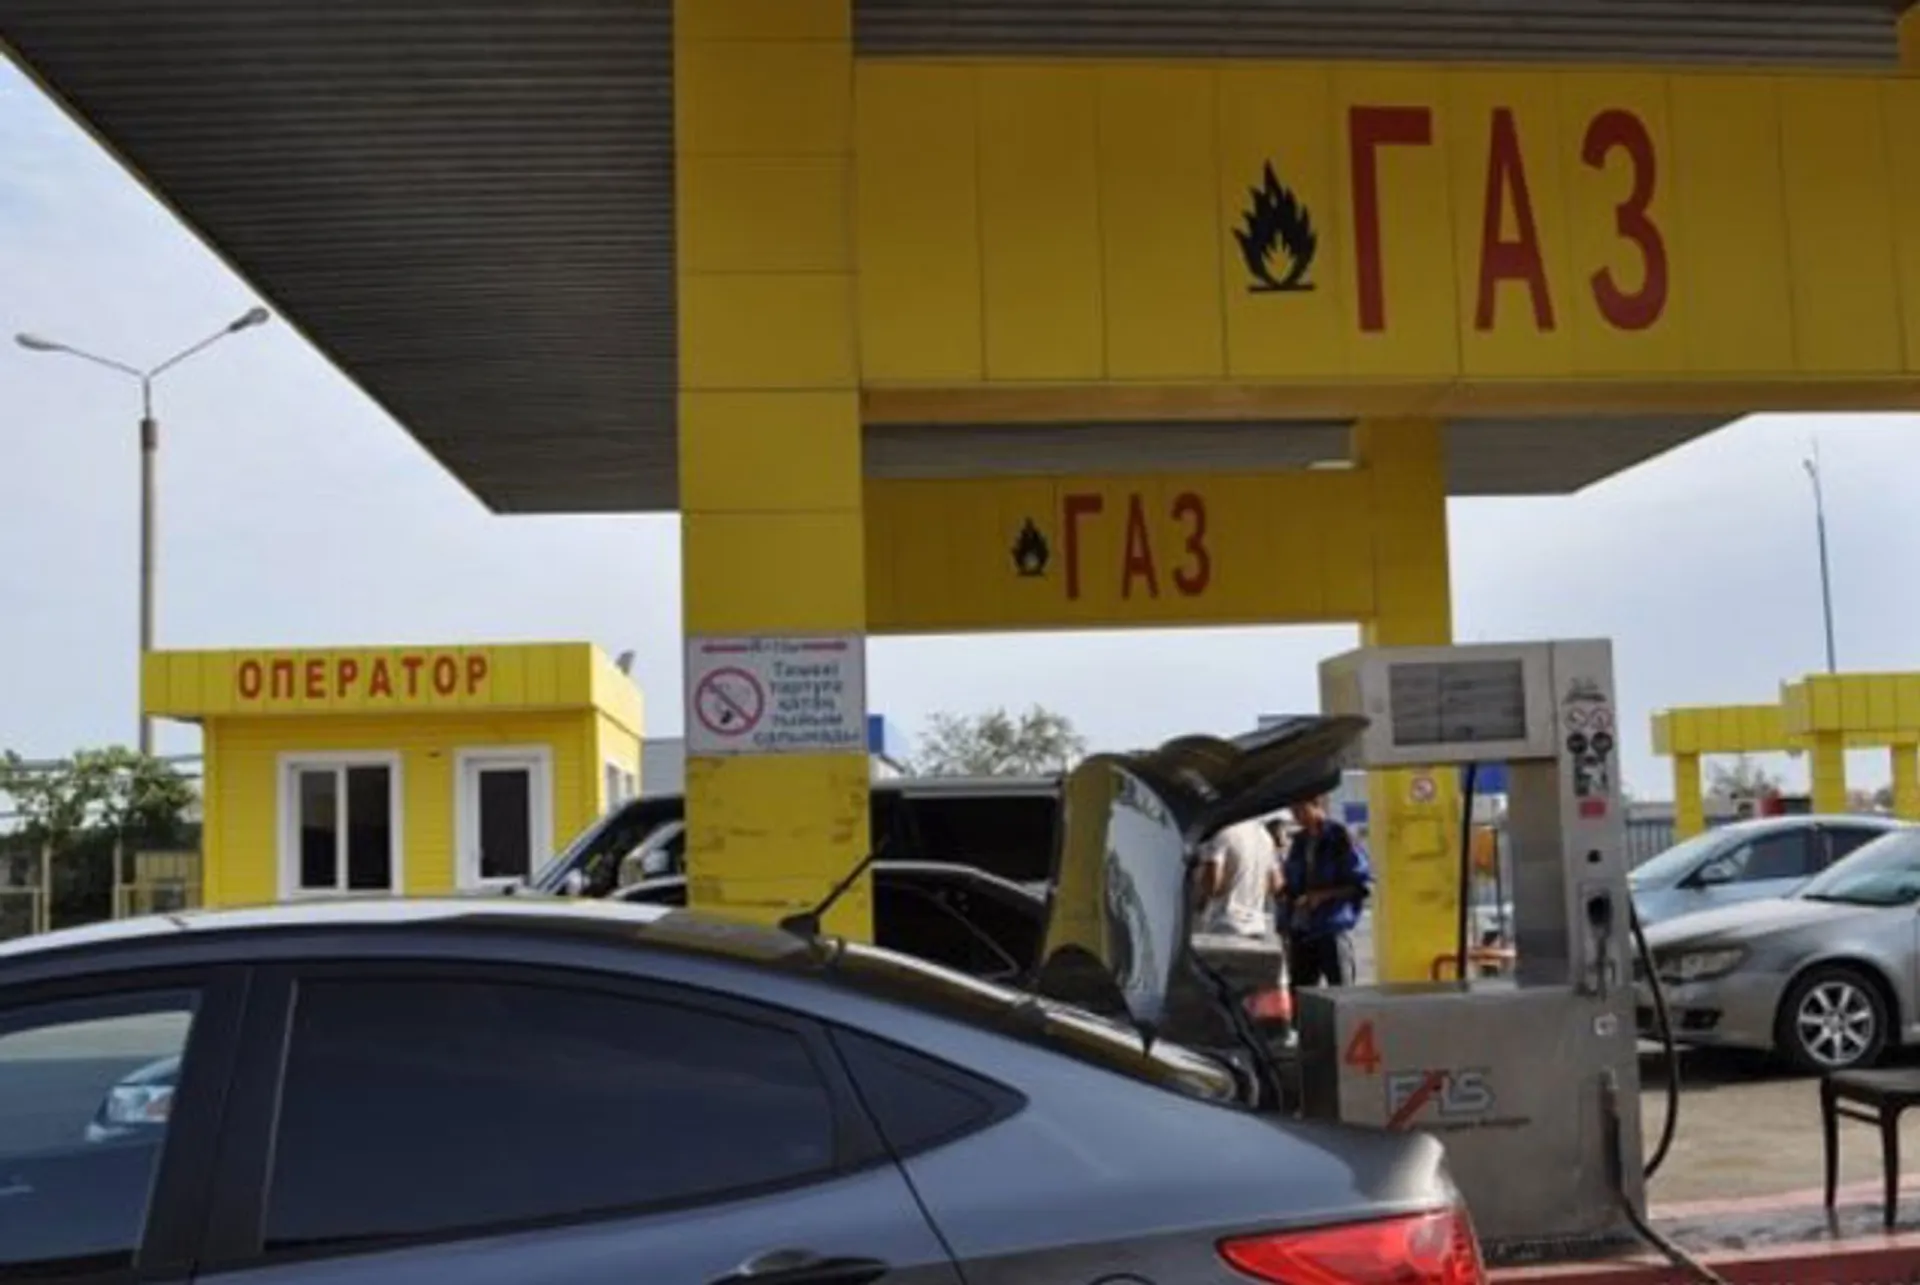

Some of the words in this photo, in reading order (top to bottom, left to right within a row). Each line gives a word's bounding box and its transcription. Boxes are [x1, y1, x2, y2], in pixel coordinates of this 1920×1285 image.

[1349, 106, 1669, 332] ГАЗ
[1062, 491, 1211, 600] ГАЗ
[237, 654, 489, 700] ОПЕРАТОР
[1345, 1019, 1381, 1074] 4
